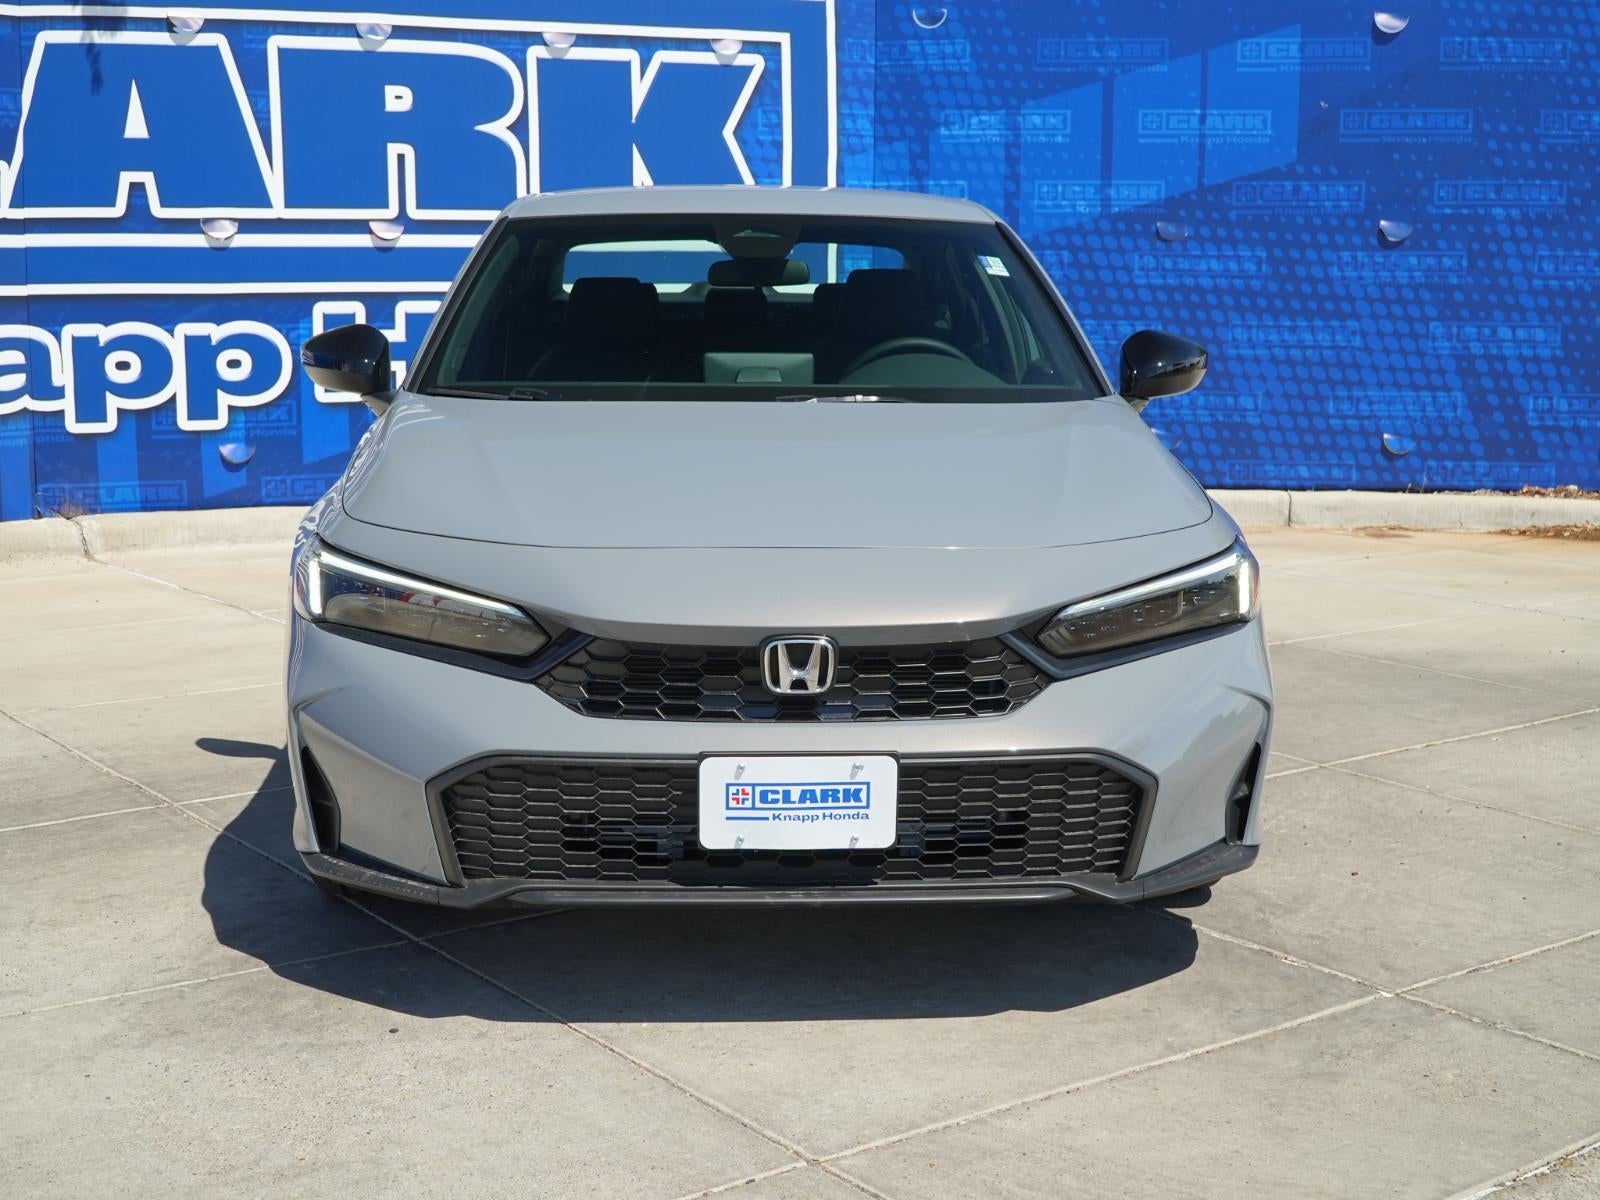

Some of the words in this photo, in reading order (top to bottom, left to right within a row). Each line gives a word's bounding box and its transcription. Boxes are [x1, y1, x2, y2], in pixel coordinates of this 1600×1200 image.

[1067, 43, 1162, 58] CLARK
[1267, 43, 1364, 57] CLARK
[1470, 42, 1563, 57] CLARK
[0, 28, 765, 221] ARK
[1168, 114, 1265, 129] CLARK
[1370, 114, 1467, 129] CLARK
[1226, 135, 1270, 144] Honda
[1064, 185, 1159, 199] CLARK
[1263, 185, 1359, 200] CLARK
[1465, 185, 1561, 199] CLARK
[759, 787, 863, 805] CLARK
[772, 812, 819, 823] Knapp
[822, 811, 870, 821] Honda
